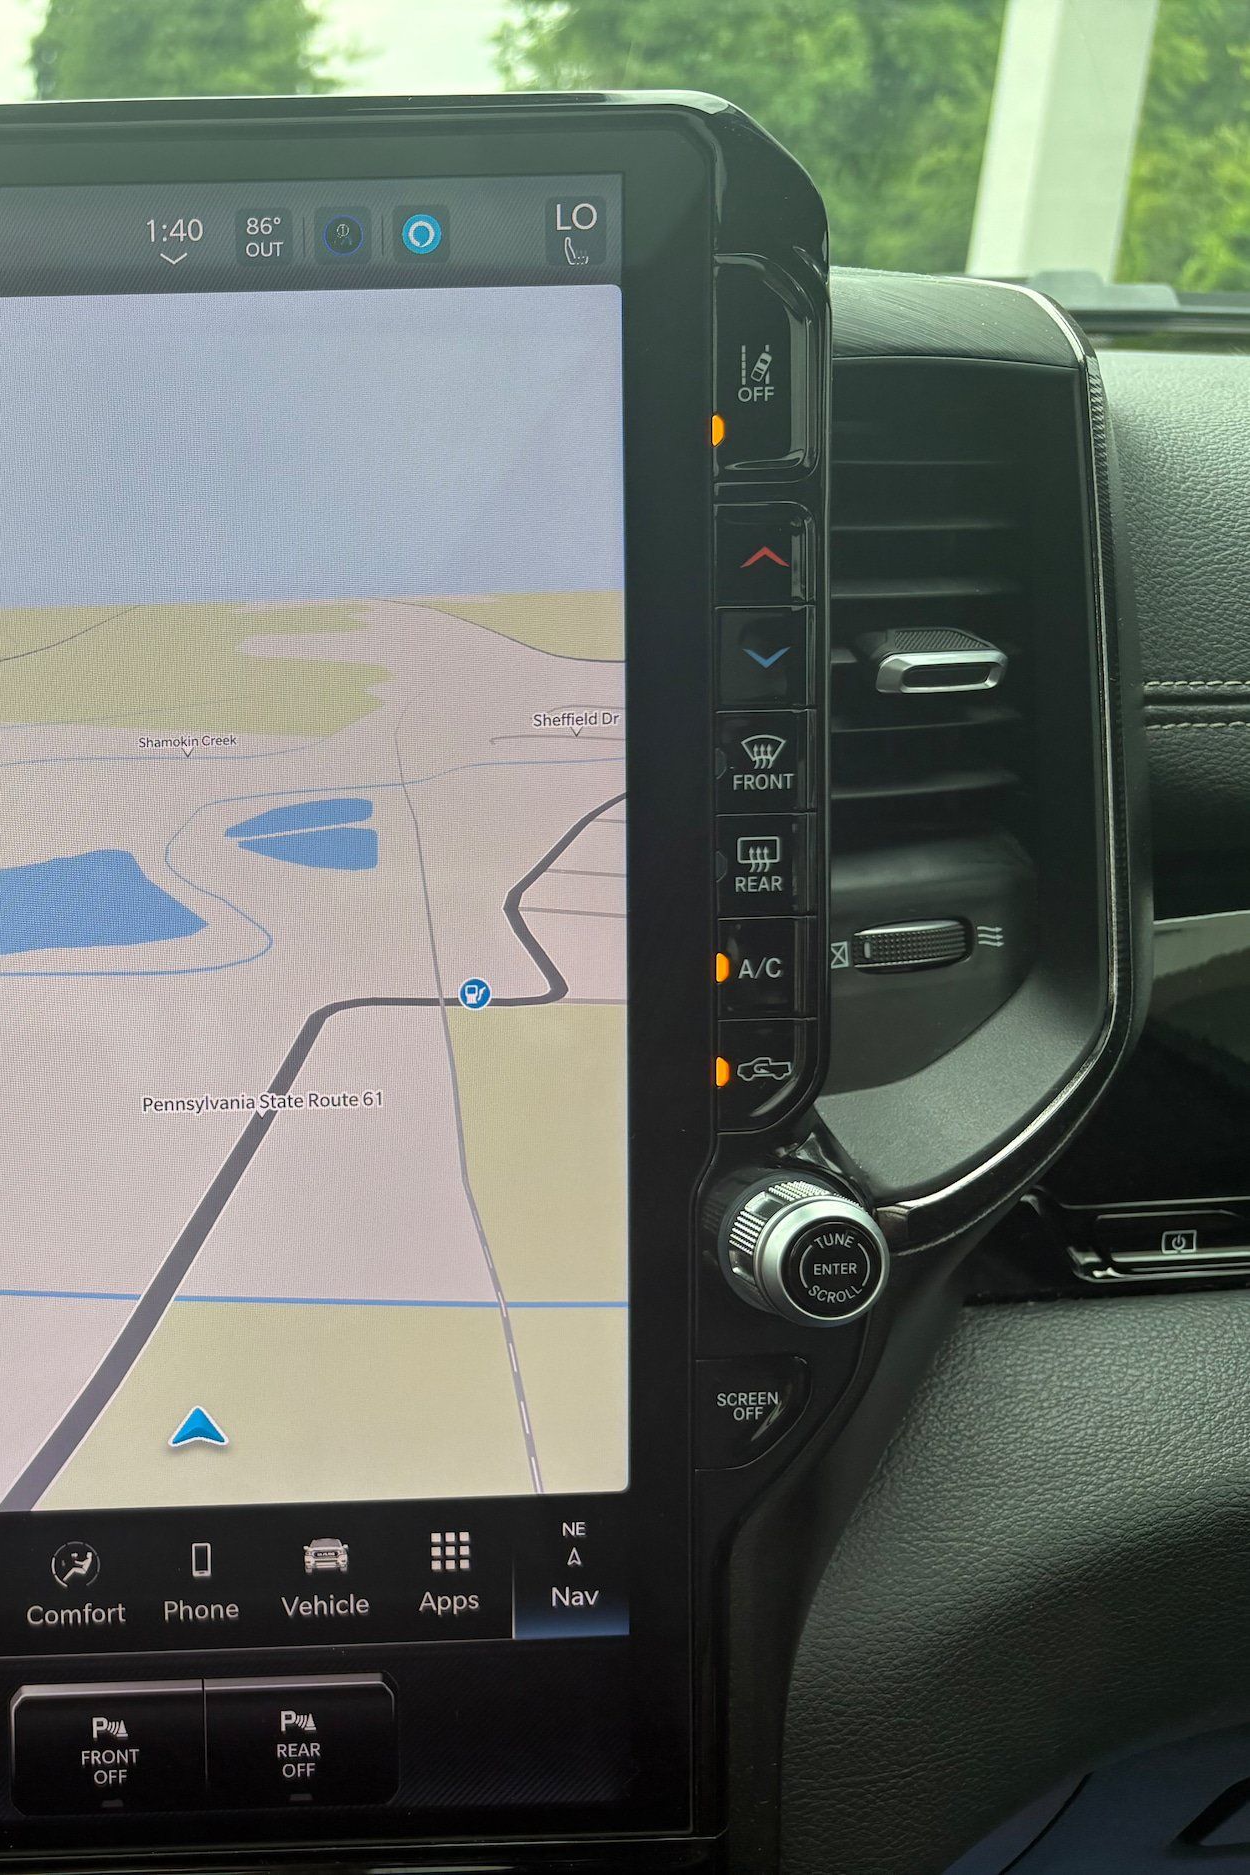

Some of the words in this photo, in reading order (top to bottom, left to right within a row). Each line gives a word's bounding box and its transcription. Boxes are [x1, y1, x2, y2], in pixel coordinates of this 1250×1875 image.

[556, 202, 598, 231] LO
[145, 218, 204, 243] 1:40
[246, 216, 282, 236] 86°
[245, 240, 284, 258] OUT
[738, 386, 775, 403] OFF
[532, 712, 599, 727] Sheffield
[601, 712, 620, 726] Dr
[138, 735, 199, 748] Shamokin
[201, 734, 238, 747] Creek
[733, 773, 795, 791] FRONT
[735, 876, 783, 892] REAR
[738, 957, 782, 979] A/C
[143, 1094, 256, 1113] Pennsylvania
[259, 1093, 304, 1109] State
[308, 1092, 359, 1108] Route
[362, 1091, 383, 1106] 61
[813, 1231, 855, 1250] TUNE
[813, 1263, 857, 1276] ENTER
[807, 1285, 862, 1304] SCROLL
[716, 1391, 779, 1407] SCREEN
[733, 1406, 764, 1421] OFF
[562, 1521, 586, 1537] NE
[281, 1594, 370, 1617] Vehicle
[419, 1591, 480, 1615] Apps
[551, 1586, 600, 1608] Nav
[26, 1602, 127, 1626] Comfort
[163, 1599, 240, 1622] Phone
[81, 1748, 140, 1767] FRONT
[276, 1742, 321, 1758] REAR
[93, 1769, 128, 1786] OFF
[282, 1762, 316, 1779] OFF
